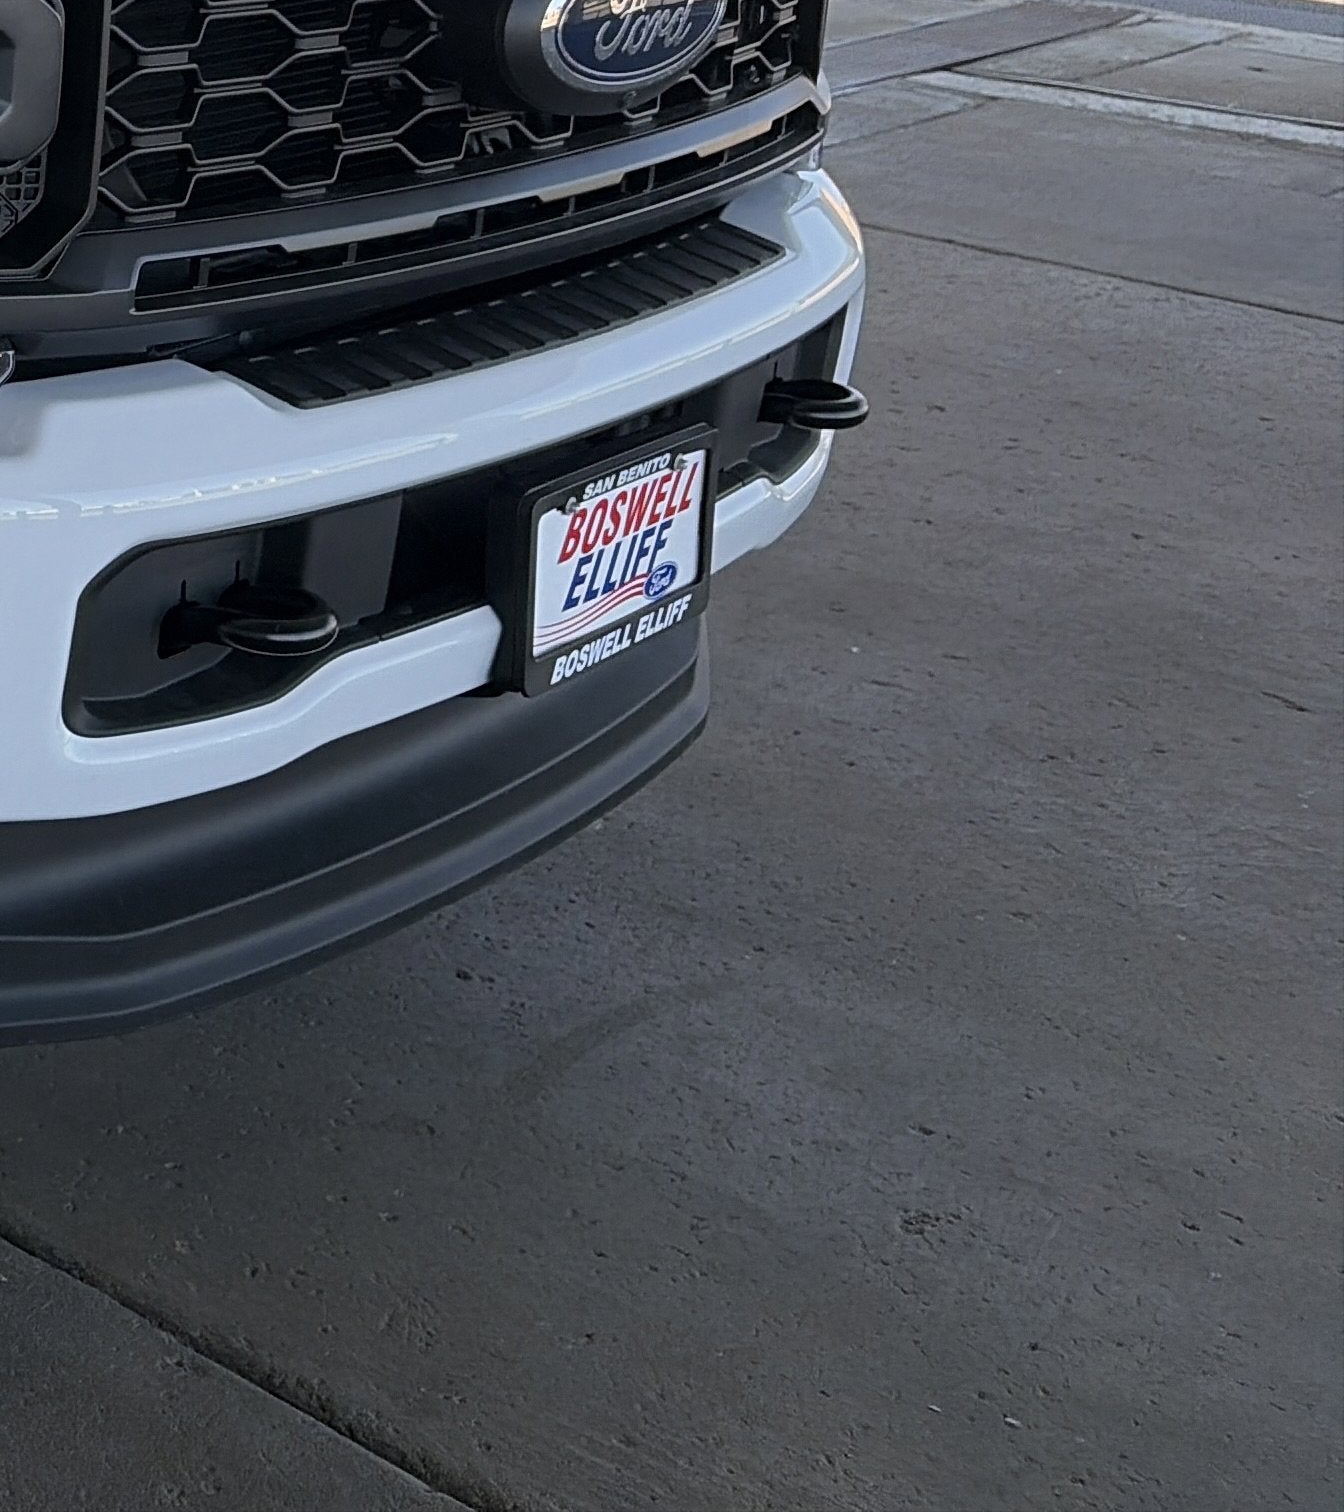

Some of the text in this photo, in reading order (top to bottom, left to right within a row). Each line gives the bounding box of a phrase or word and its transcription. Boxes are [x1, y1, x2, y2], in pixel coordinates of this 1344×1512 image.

[557, 461, 699, 565] BOSWELL
[582, 452, 671, 500] SAN BENITO
[562, 518, 674, 612] ELLIFF
[648, 566, 673, 596] Ford
[550, 593, 693, 686] BOSWELL ELLIFF
